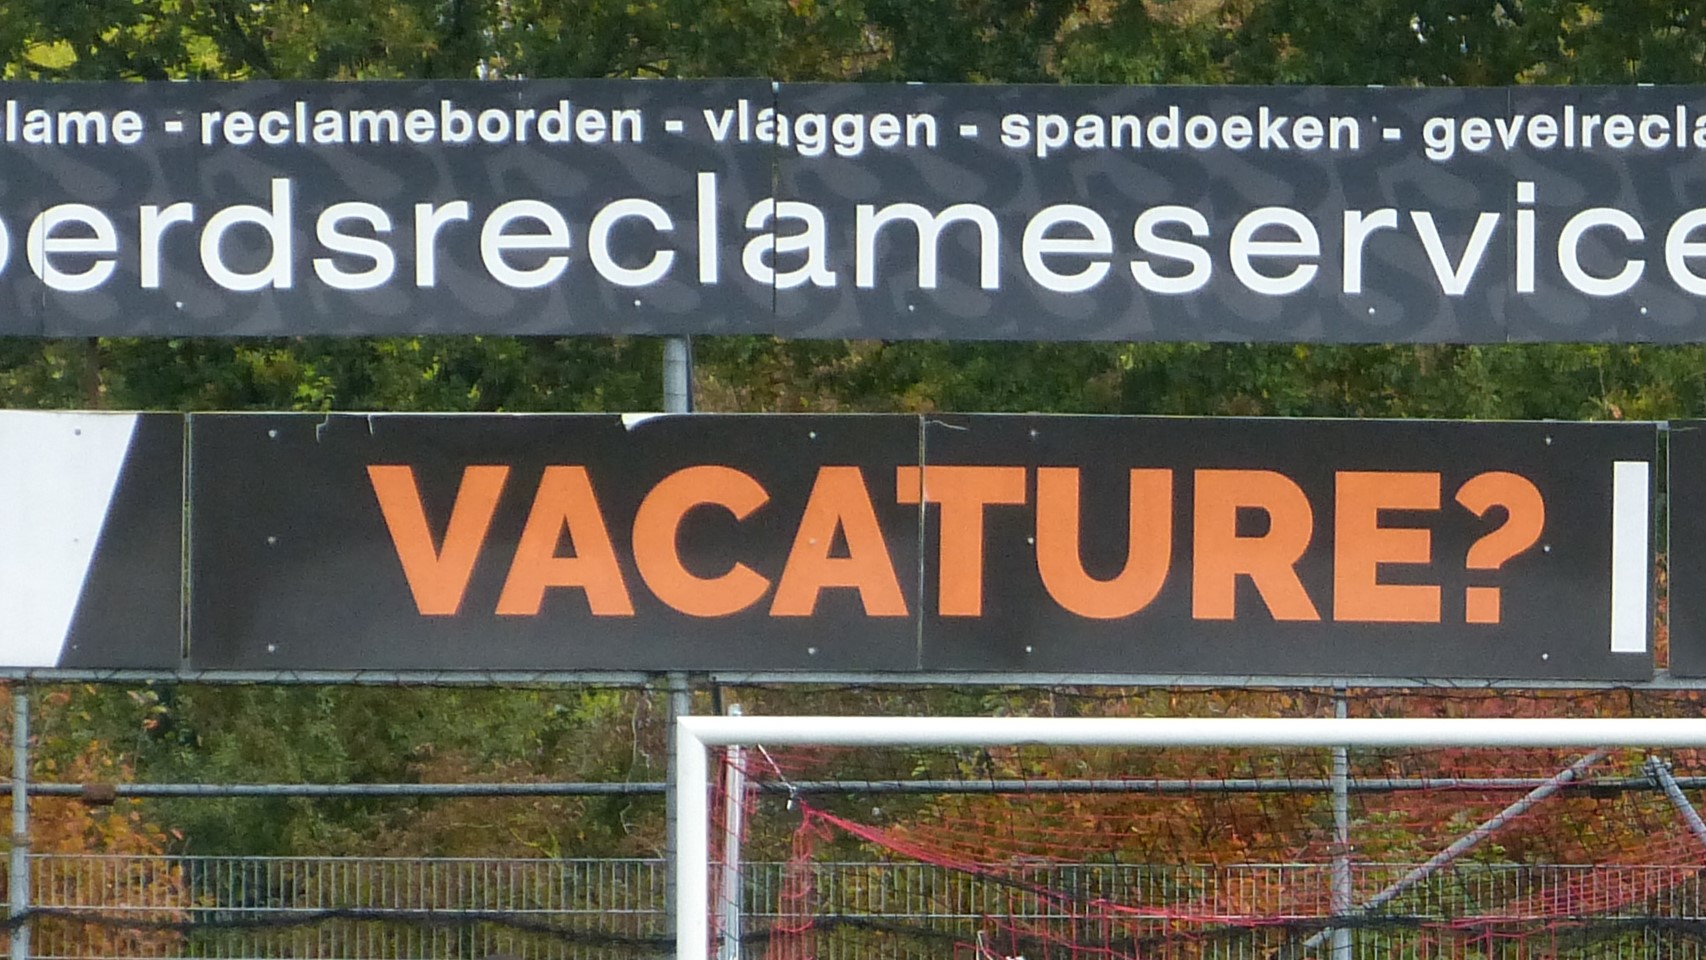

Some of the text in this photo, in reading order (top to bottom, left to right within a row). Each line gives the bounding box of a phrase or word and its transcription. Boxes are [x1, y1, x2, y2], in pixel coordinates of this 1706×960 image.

[201, 100, 642, 146] reclameborden
[703, 99, 937, 157] vlaggen
[1000, 105, 1360, 158] spandoeken
[367, 465, 1545, 623] VACATURE?
